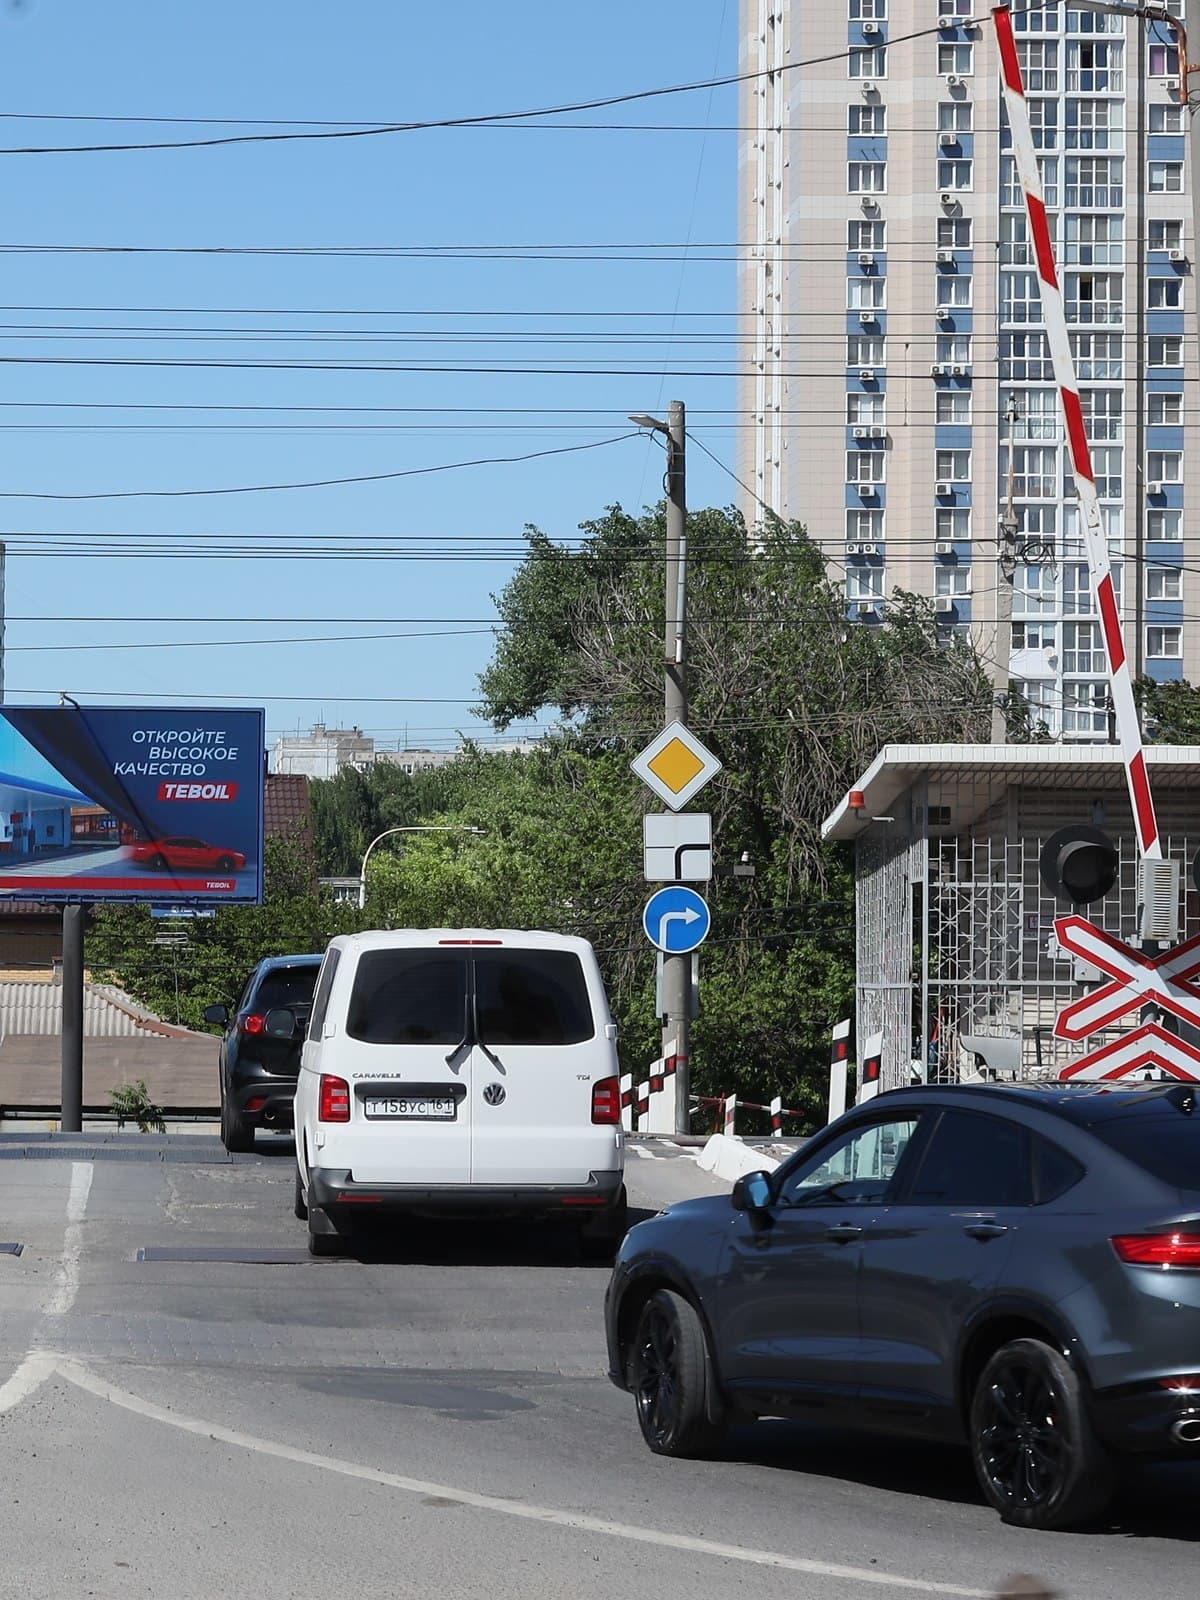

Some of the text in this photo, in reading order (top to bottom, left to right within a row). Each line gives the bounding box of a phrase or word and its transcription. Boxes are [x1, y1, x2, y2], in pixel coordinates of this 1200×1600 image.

[132, 728, 226, 744] ОТКРОЙТЕ
[149, 746, 239, 760] ВЫСОКОЕ
[113, 762, 206, 776] КАЧЕСТВО
[165, 784, 230, 799] TEBOIL
[430, 1099, 450, 1110] 161
